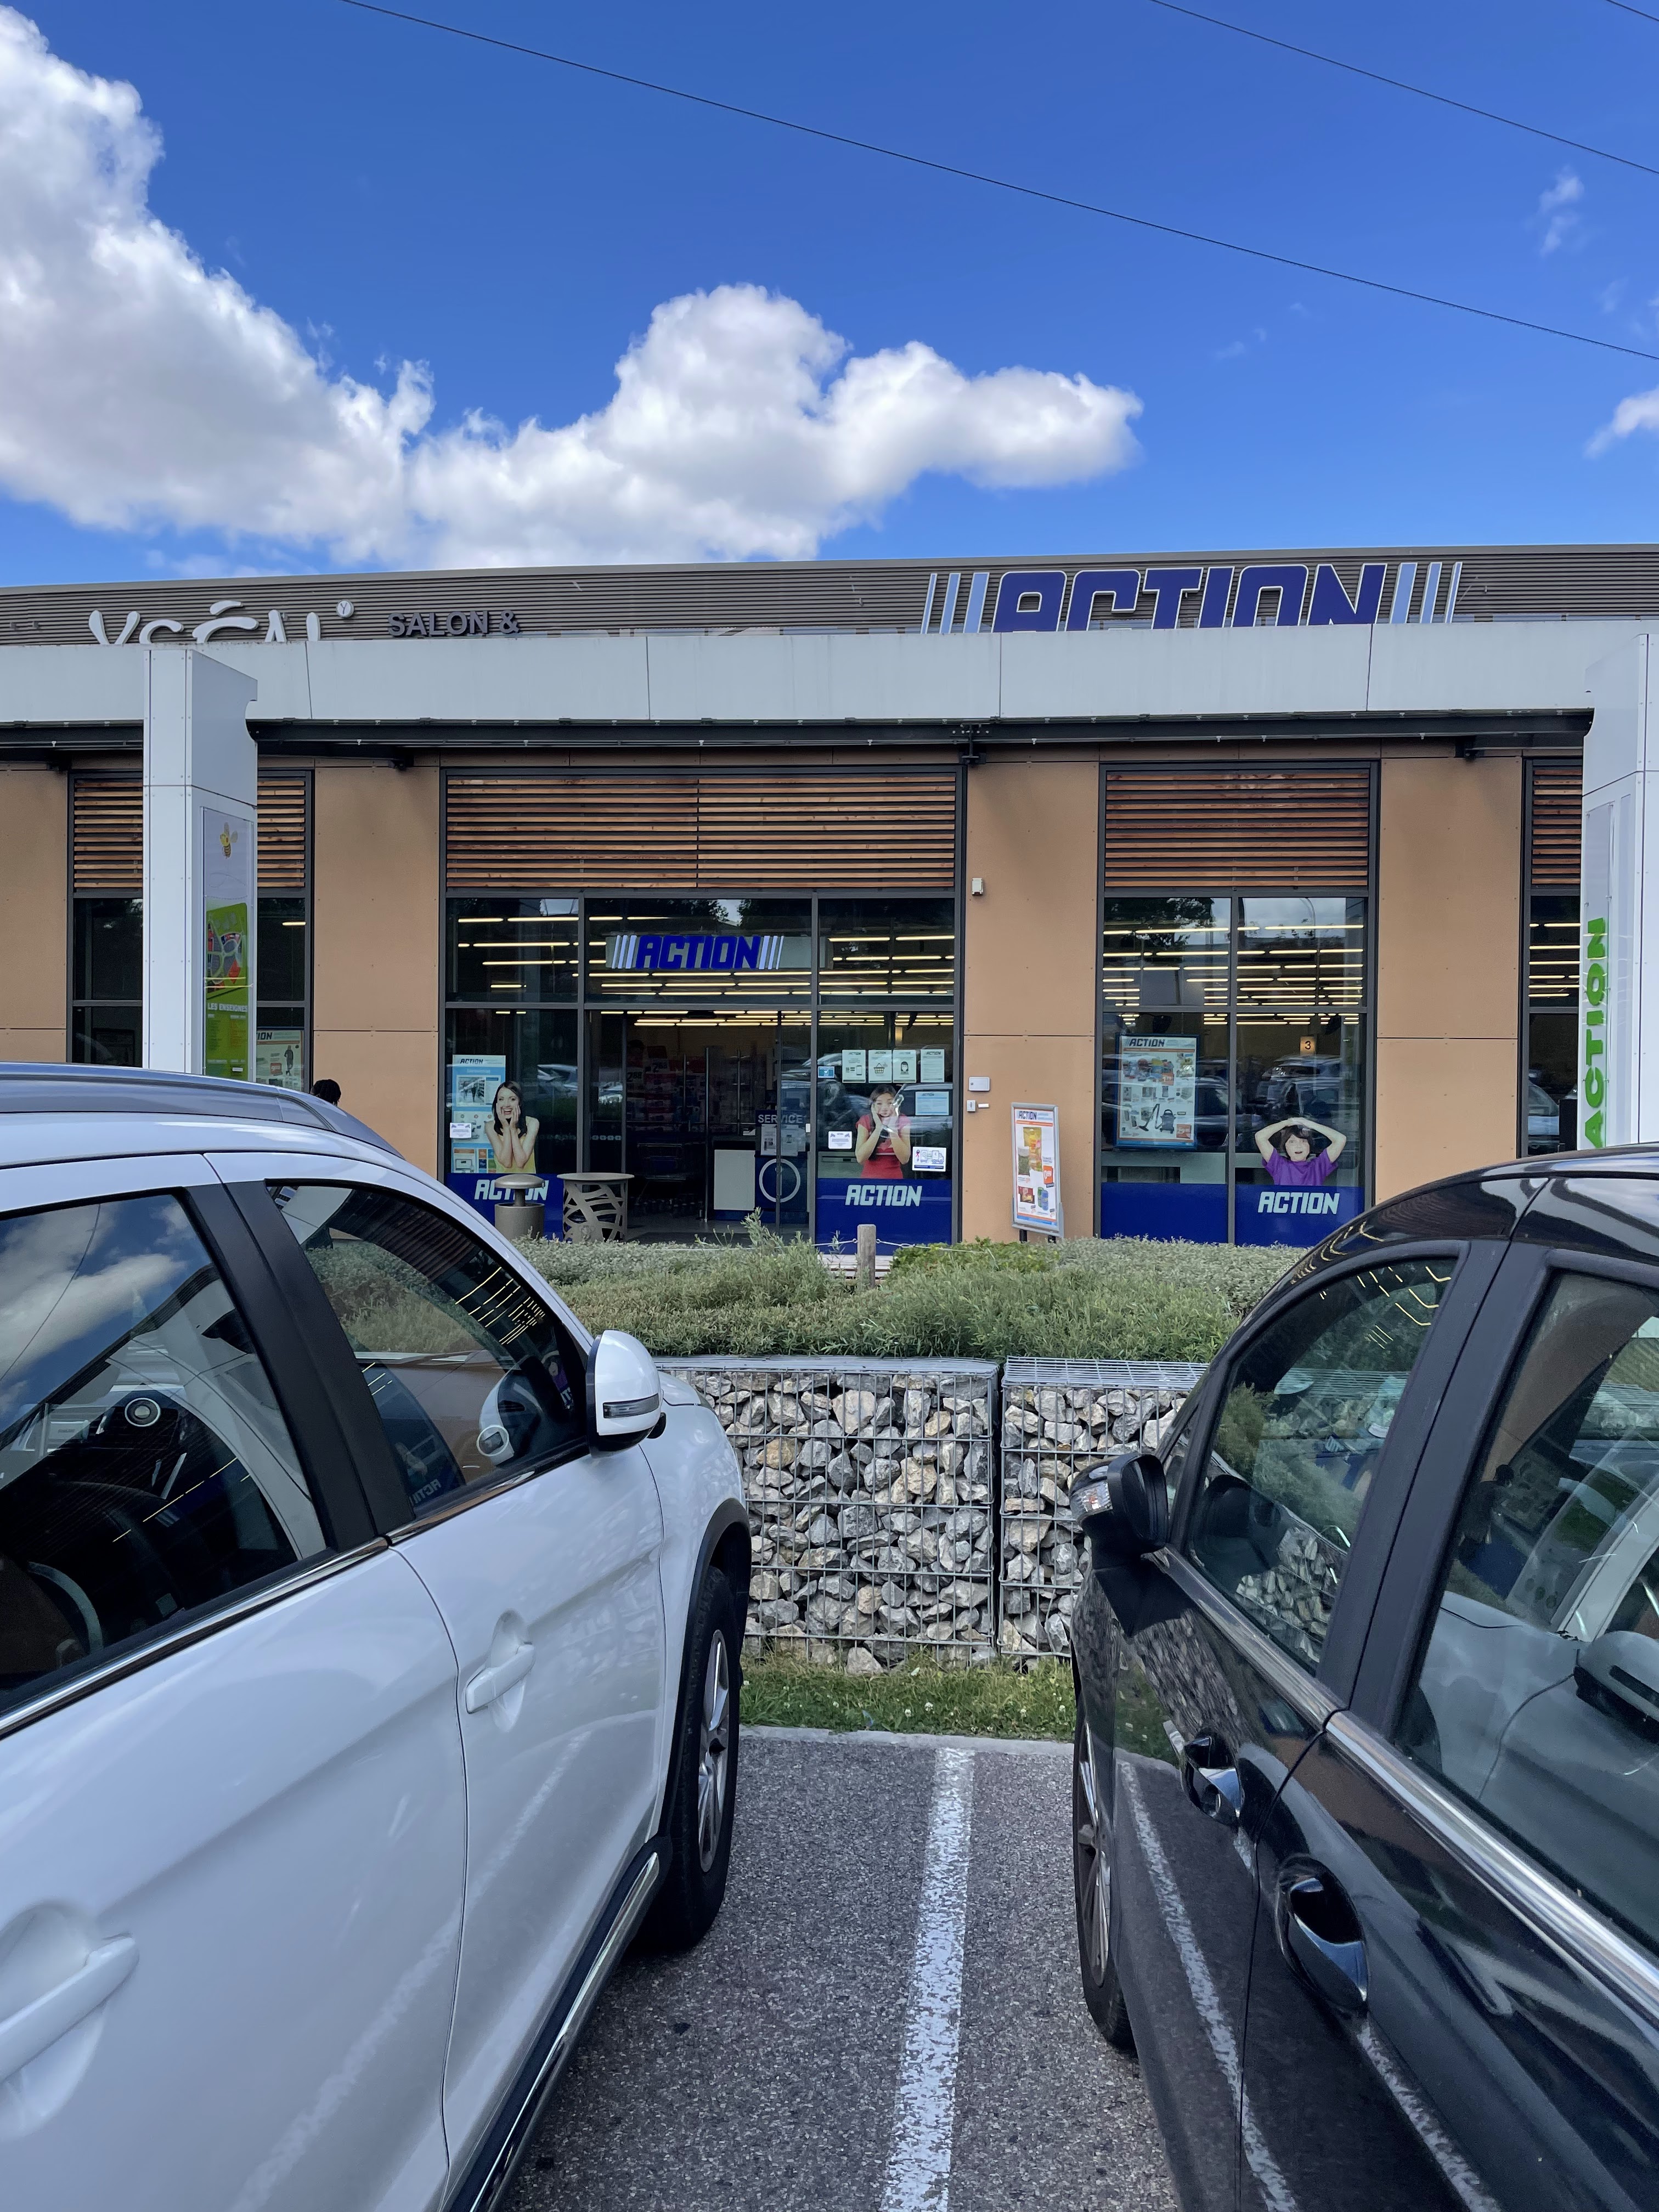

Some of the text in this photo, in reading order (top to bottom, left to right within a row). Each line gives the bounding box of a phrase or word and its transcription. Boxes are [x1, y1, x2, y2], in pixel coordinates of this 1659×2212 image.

[992, 563, 1388, 632] ACTION
[387, 610, 520, 637] SALON &
[636, 935, 761, 970] ACTION
[256, 1032, 273, 1040] ION
[1129, 1038, 1165, 1047] ACTION
[1585, 918, 1605, 1148] ACTION
[1305, 1040, 1311, 1050] 3
[758, 1114, 803, 1124] SERVICE
[1018, 1110, 1037, 1120] ACTION
[474, 1179, 549, 1200] ACTN
[845, 1184, 922, 1207] ACTION
[1257, 1192, 1340, 1215] ACTION
